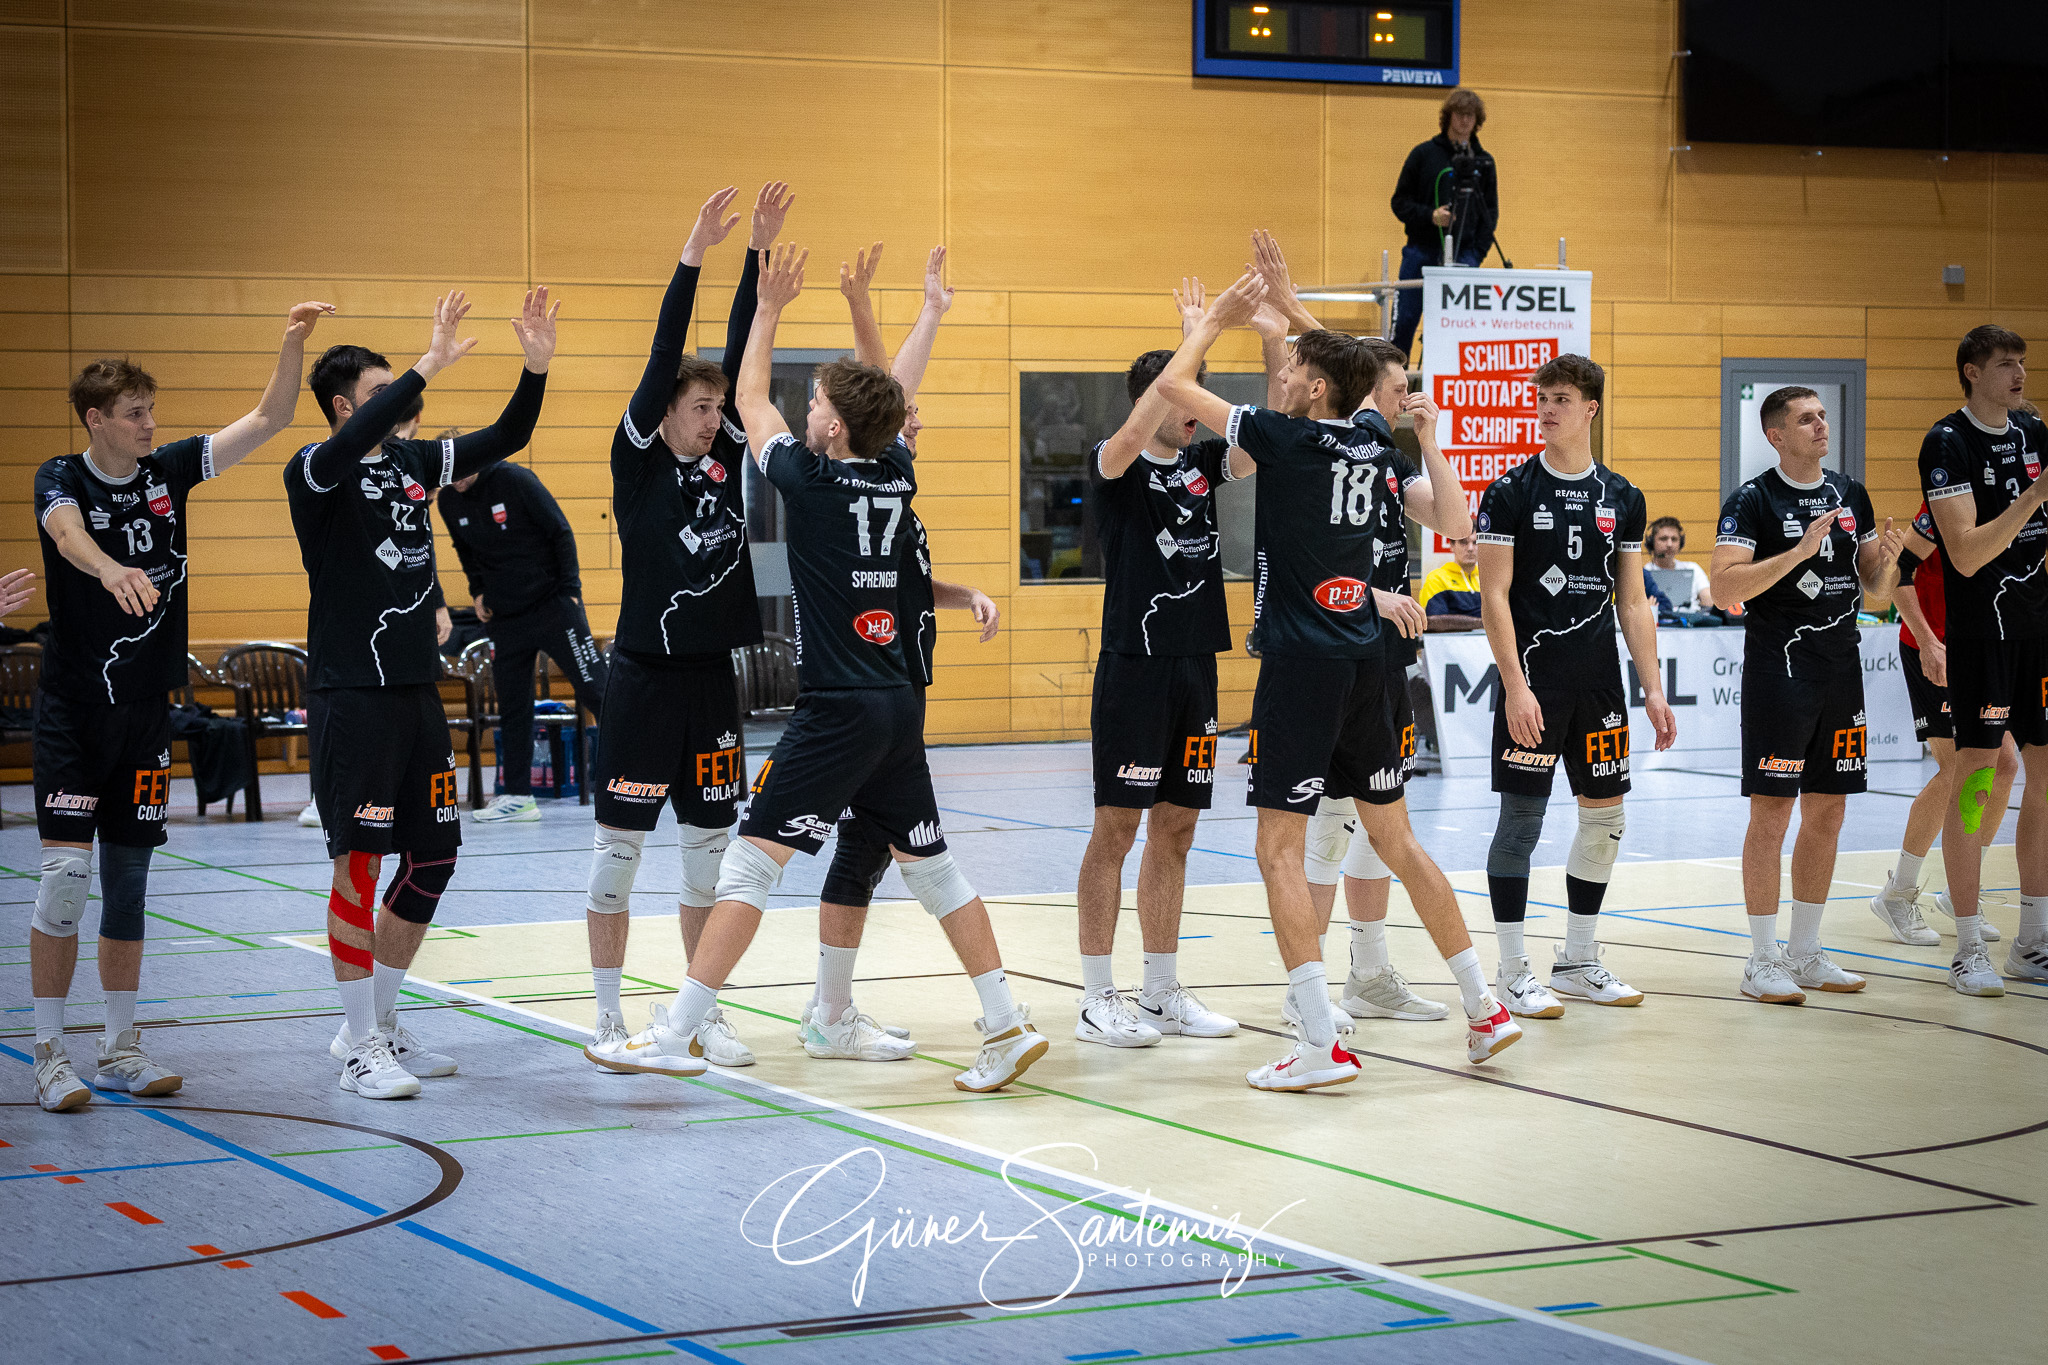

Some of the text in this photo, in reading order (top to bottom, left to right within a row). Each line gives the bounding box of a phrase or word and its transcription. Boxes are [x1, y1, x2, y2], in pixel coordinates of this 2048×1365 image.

[1382, 69, 1443, 84] PEWETA
[1441, 284, 1575, 312] MEYSEL
[1441, 317, 1477, 329] Druck
[1491, 318, 1574, 330] Werbetechnik
[1463, 343, 1551, 373] SCHILDER
[1442, 380, 1539, 408] FOTOTAPE
[150, 487, 165, 499] TVR
[1191, 480, 1207, 493] 1861
[1330, 459, 1378, 526] 18
[1555, 489, 1589, 498] RE/MAX
[152, 502, 170, 512] 1861
[1564, 503, 1583, 511] JAKO
[1798, 497, 1828, 507] RE/MAX
[390, 500, 417, 531] 12
[1598, 509, 1613, 517] TVR
[849, 495, 903, 555] 17
[1598, 520, 1614, 528] 1861
[1840, 520, 1855, 528] 1861
[121, 518, 154, 555] 13
[1567, 525, 1583, 560] 5
[1819, 534, 1835, 562] 4
[1544, 576, 1564, 584] SWR
[1568, 574, 1602, 583] Stadtwerke
[1801, 580, 1819, 589] SWR
[1824, 575, 1852, 584] Stadtwerke
[1568, 581, 1607, 593] Rottenburg
[1824, 581, 1856, 591] Rottenburg
[1328, 584, 1364, 605] p+p
[1914, 716, 1928, 730] RAL
[1832, 725, 1867, 759] FET
[430, 769, 458, 808] FE
